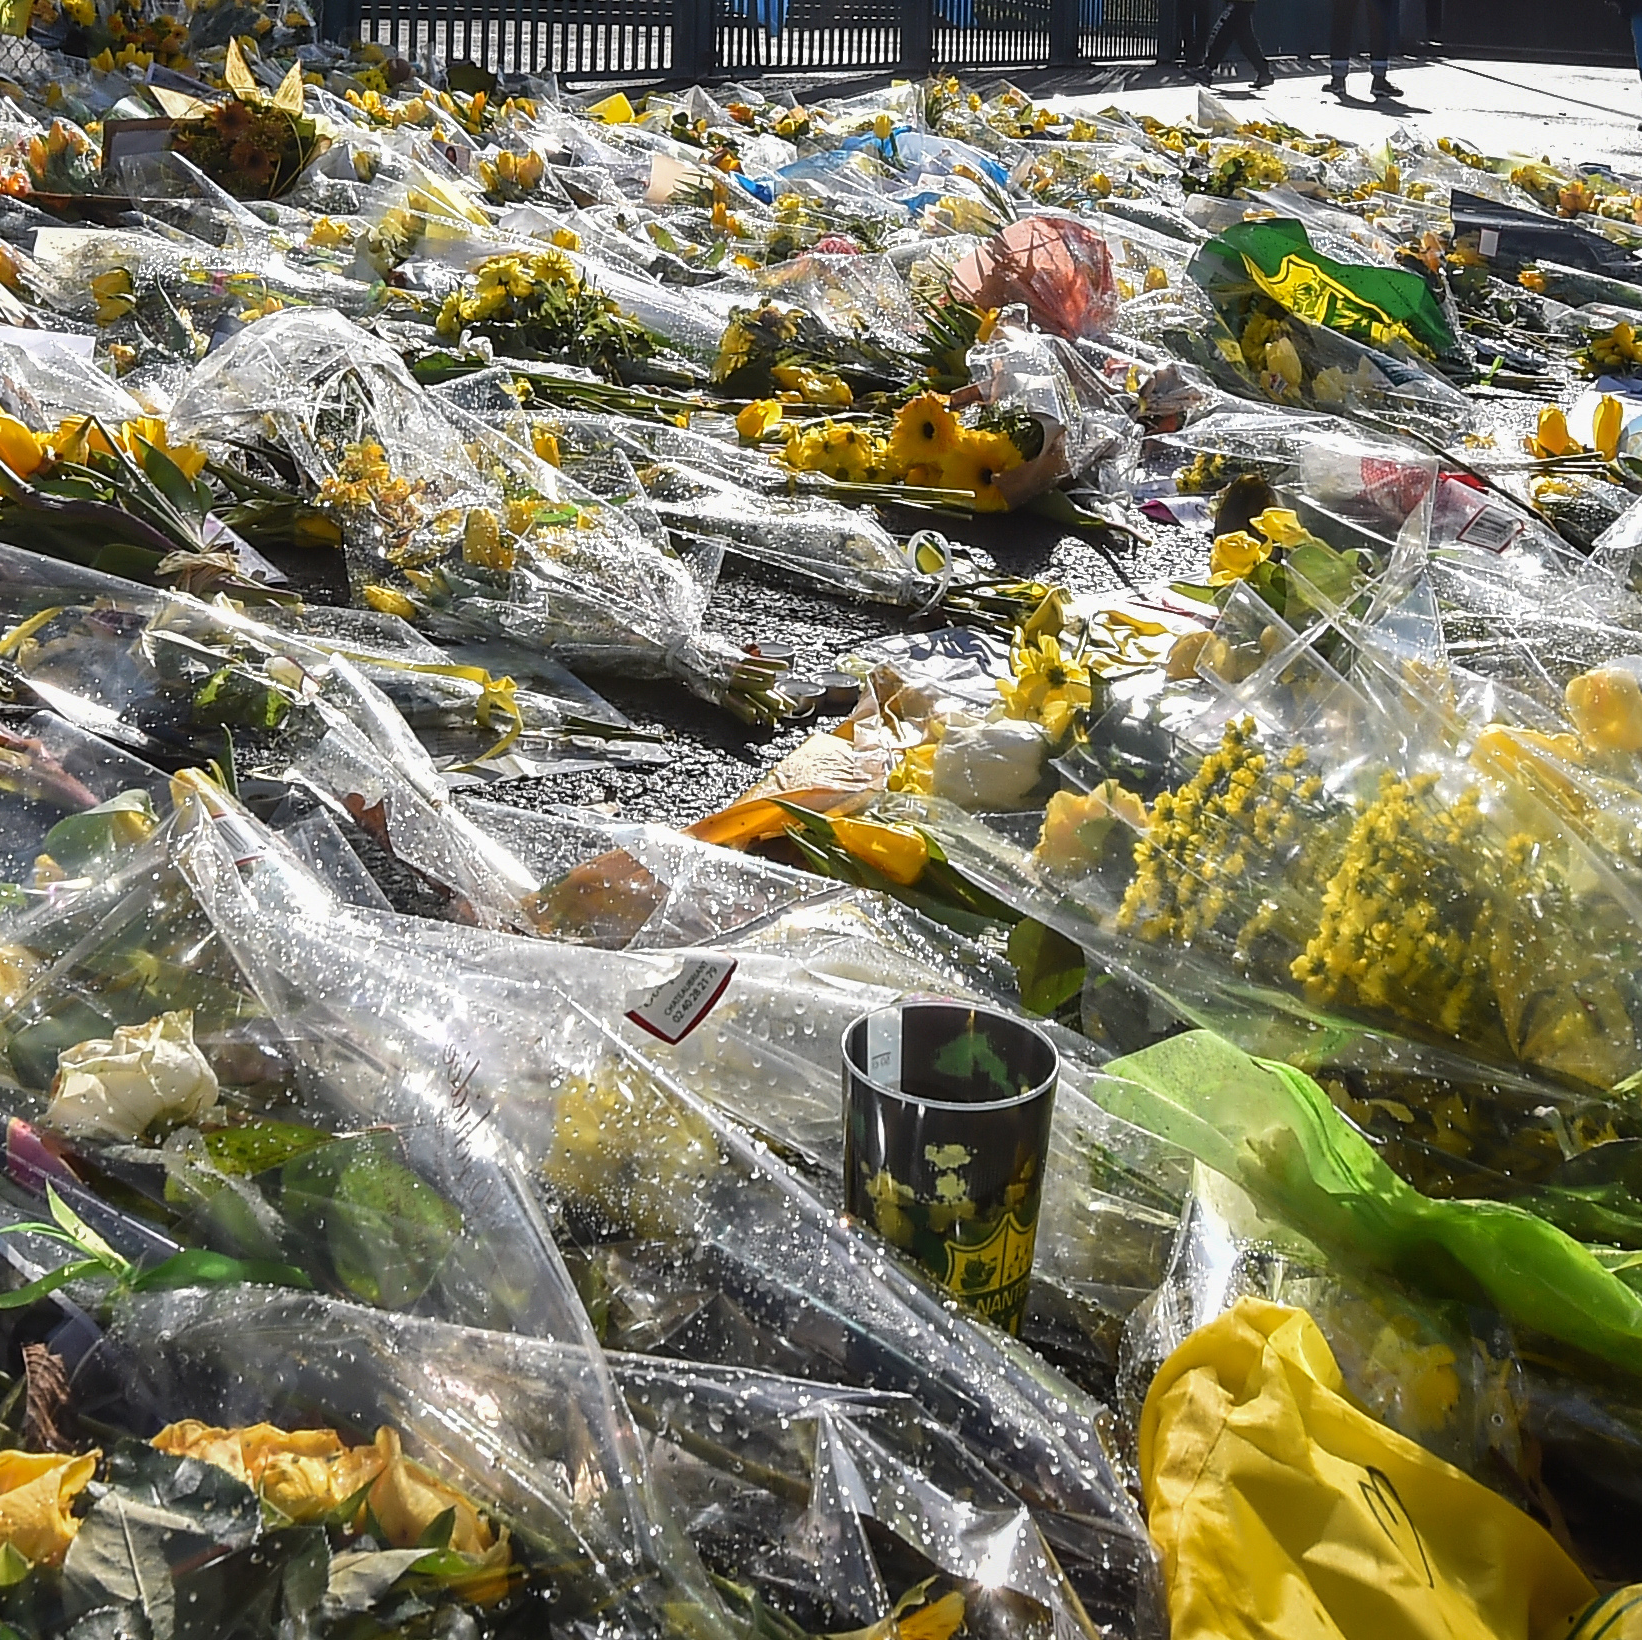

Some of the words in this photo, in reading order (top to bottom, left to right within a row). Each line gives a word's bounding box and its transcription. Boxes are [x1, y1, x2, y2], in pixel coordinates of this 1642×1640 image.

[672, 1010, 684, 1023] 02
[682, 1000, 694, 1012] 40
[690, 987, 703, 1001] 28
[698, 978, 710, 991] 21
[708, 966, 719, 979] 79
